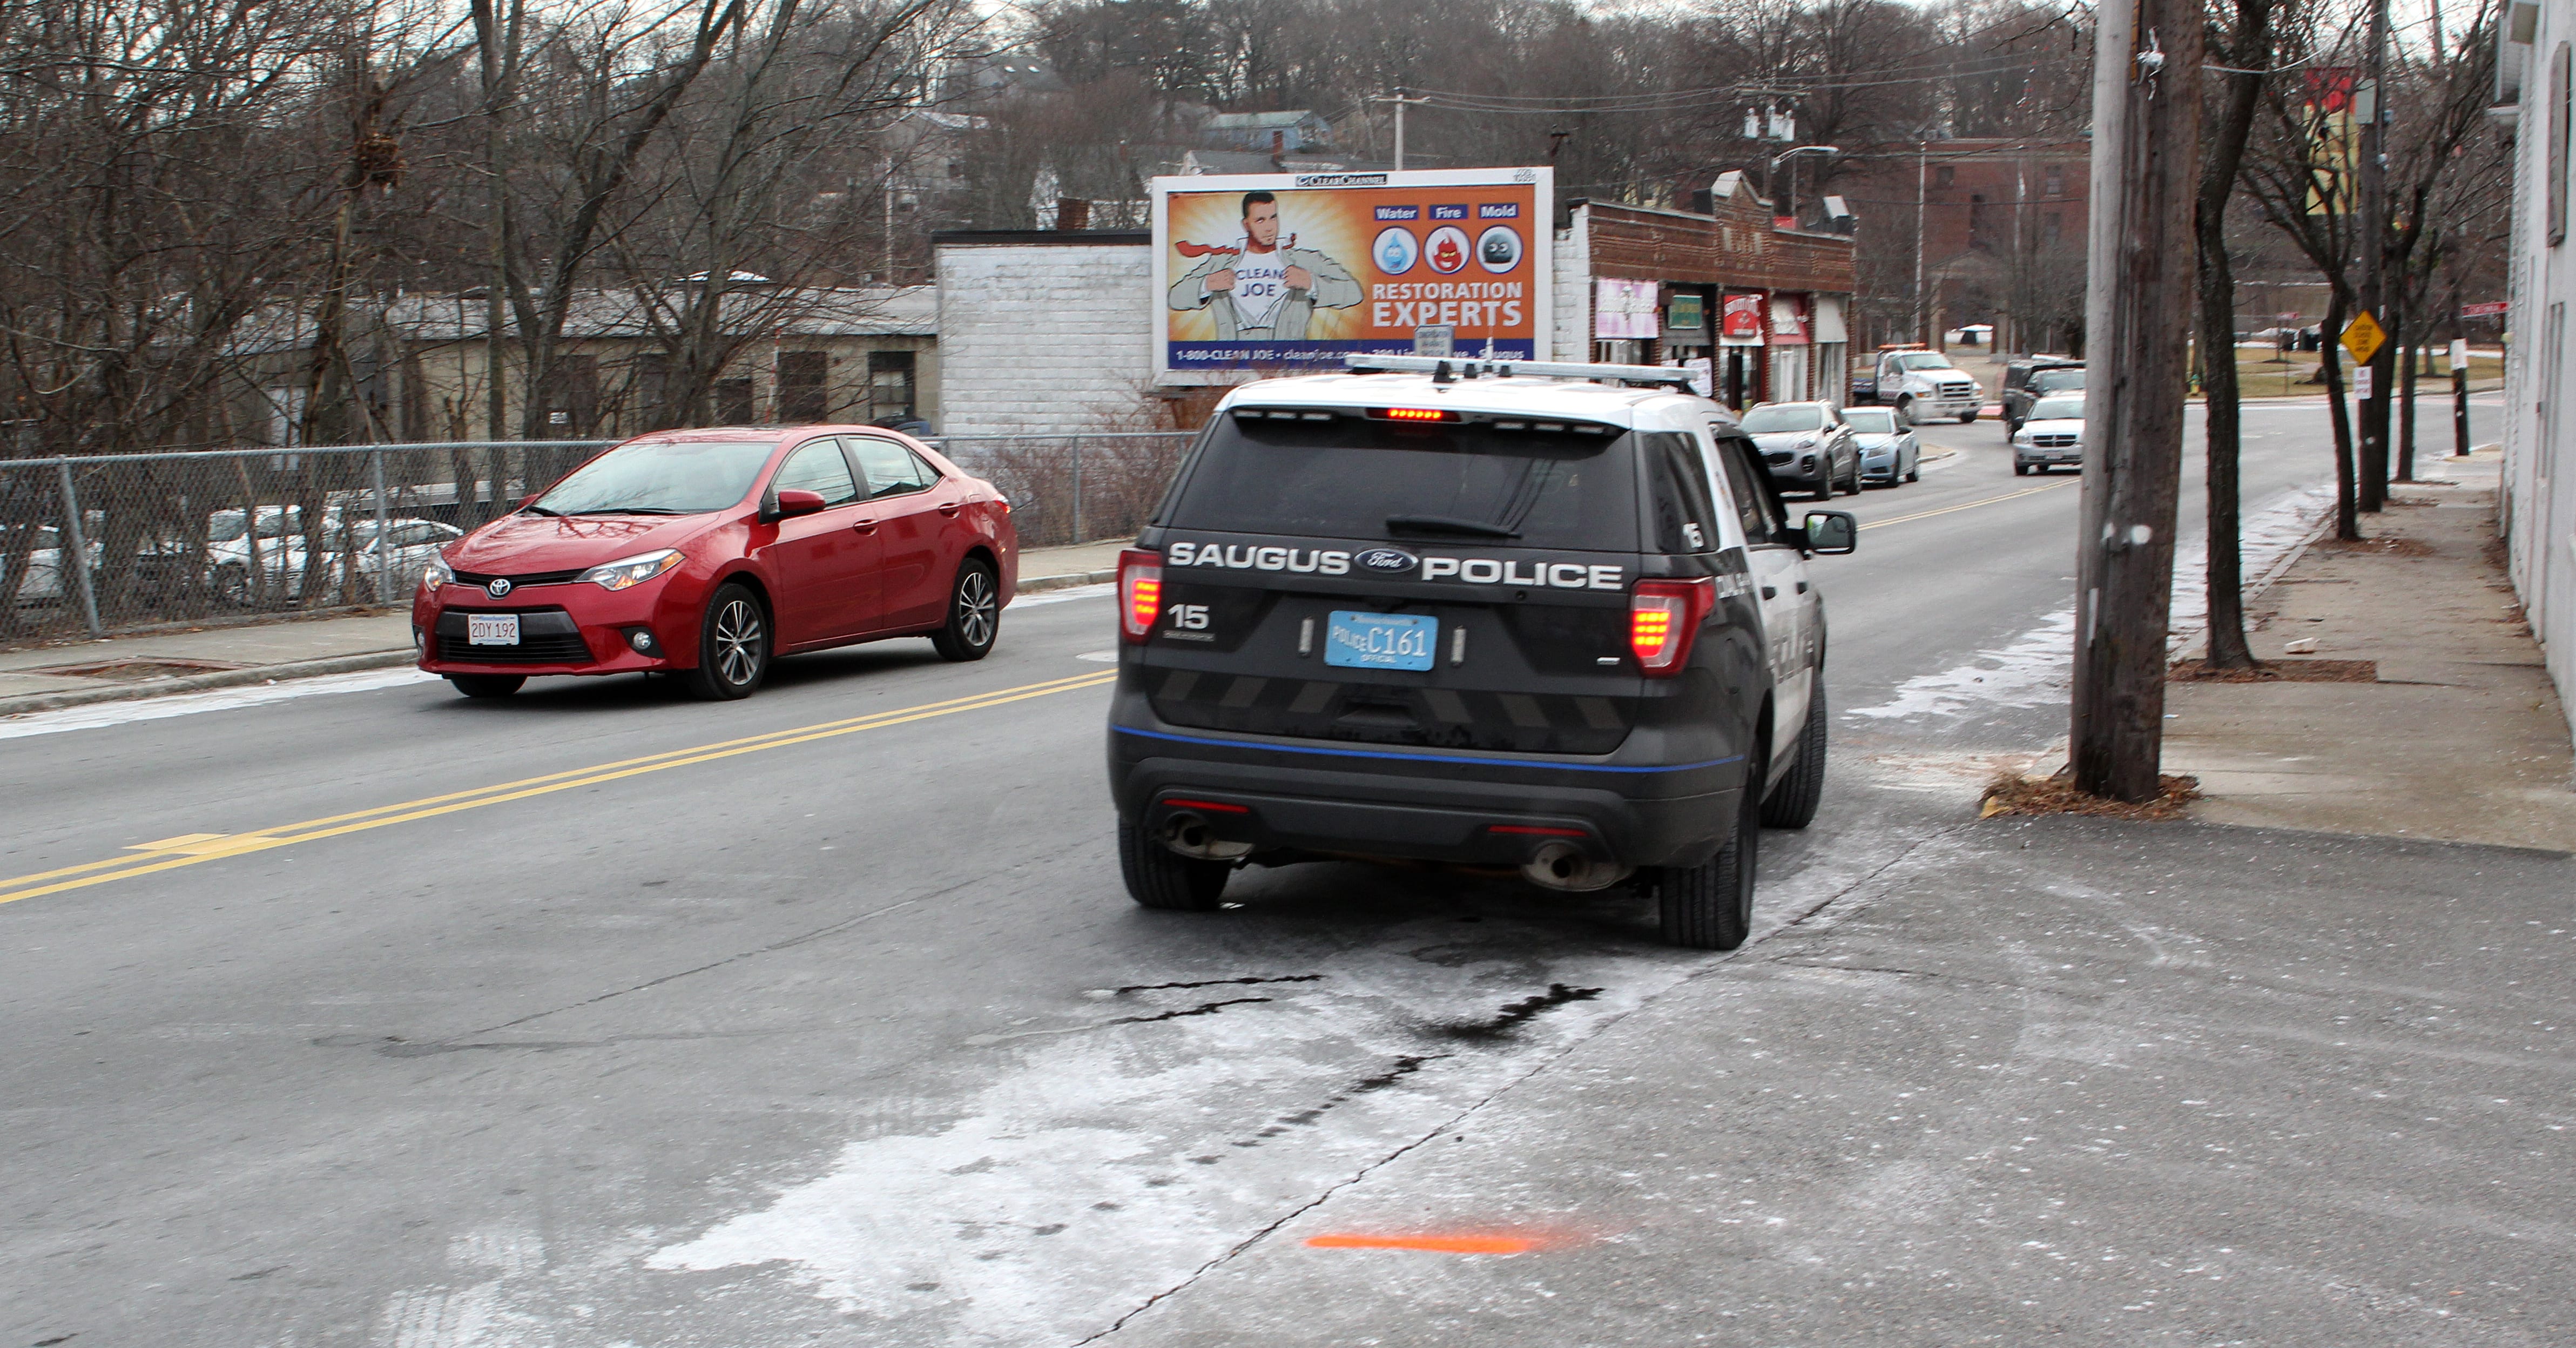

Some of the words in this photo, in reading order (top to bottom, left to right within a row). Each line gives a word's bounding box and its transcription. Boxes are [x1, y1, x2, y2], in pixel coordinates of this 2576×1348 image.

[1377, 207, 1417, 220] Water
[1435, 207, 1461, 218] Fire
[1480, 205, 1516, 218] Mold
[1236, 268, 1284, 280] CLEAN
[1240, 283, 1277, 297] JOE
[1372, 281, 1523, 300] RESTORATION
[1372, 300, 1523, 327] EXPERTS
[1176, 350, 1250, 361] 1-800-CLEAN
[1252, 350, 1274, 360] JOE
[1478, 348, 1525, 360] Sugus
[1683, 522, 1704, 549] 15
[1168, 542, 1351, 575] SAUGUS
[1367, 551, 1404, 570] Ford
[1421, 557, 1623, 590] POLICE
[1168, 603, 1210, 630] 15
[471, 623, 492, 638] 2DY
[495, 623, 516, 638] 192
[1332, 625, 1367, 651] POLICE
[1367, 626, 1427, 657] C161
